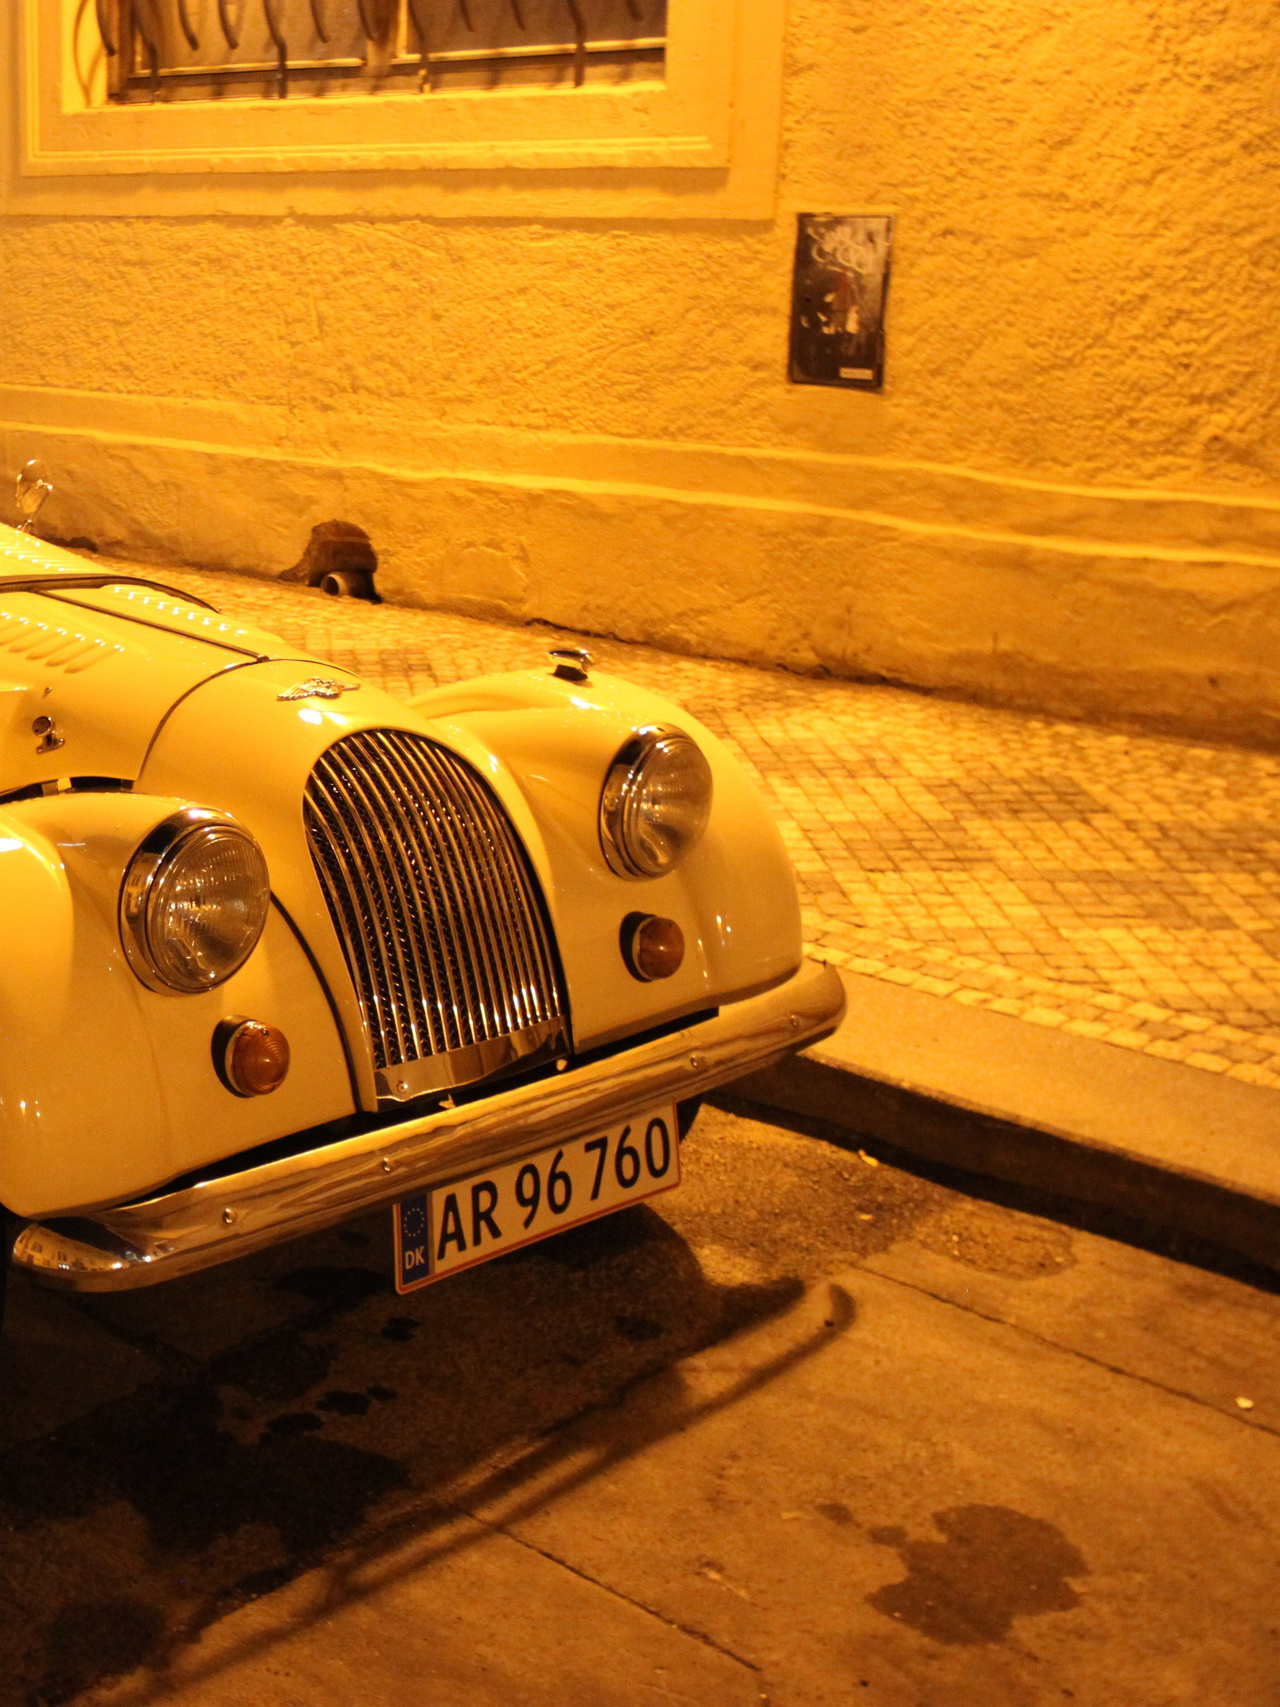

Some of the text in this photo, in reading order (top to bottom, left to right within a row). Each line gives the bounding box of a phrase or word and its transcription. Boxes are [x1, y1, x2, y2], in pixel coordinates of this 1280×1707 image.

[437, 1117, 670, 1261] AR 96 760
[405, 1246, 425, 1269] DK
